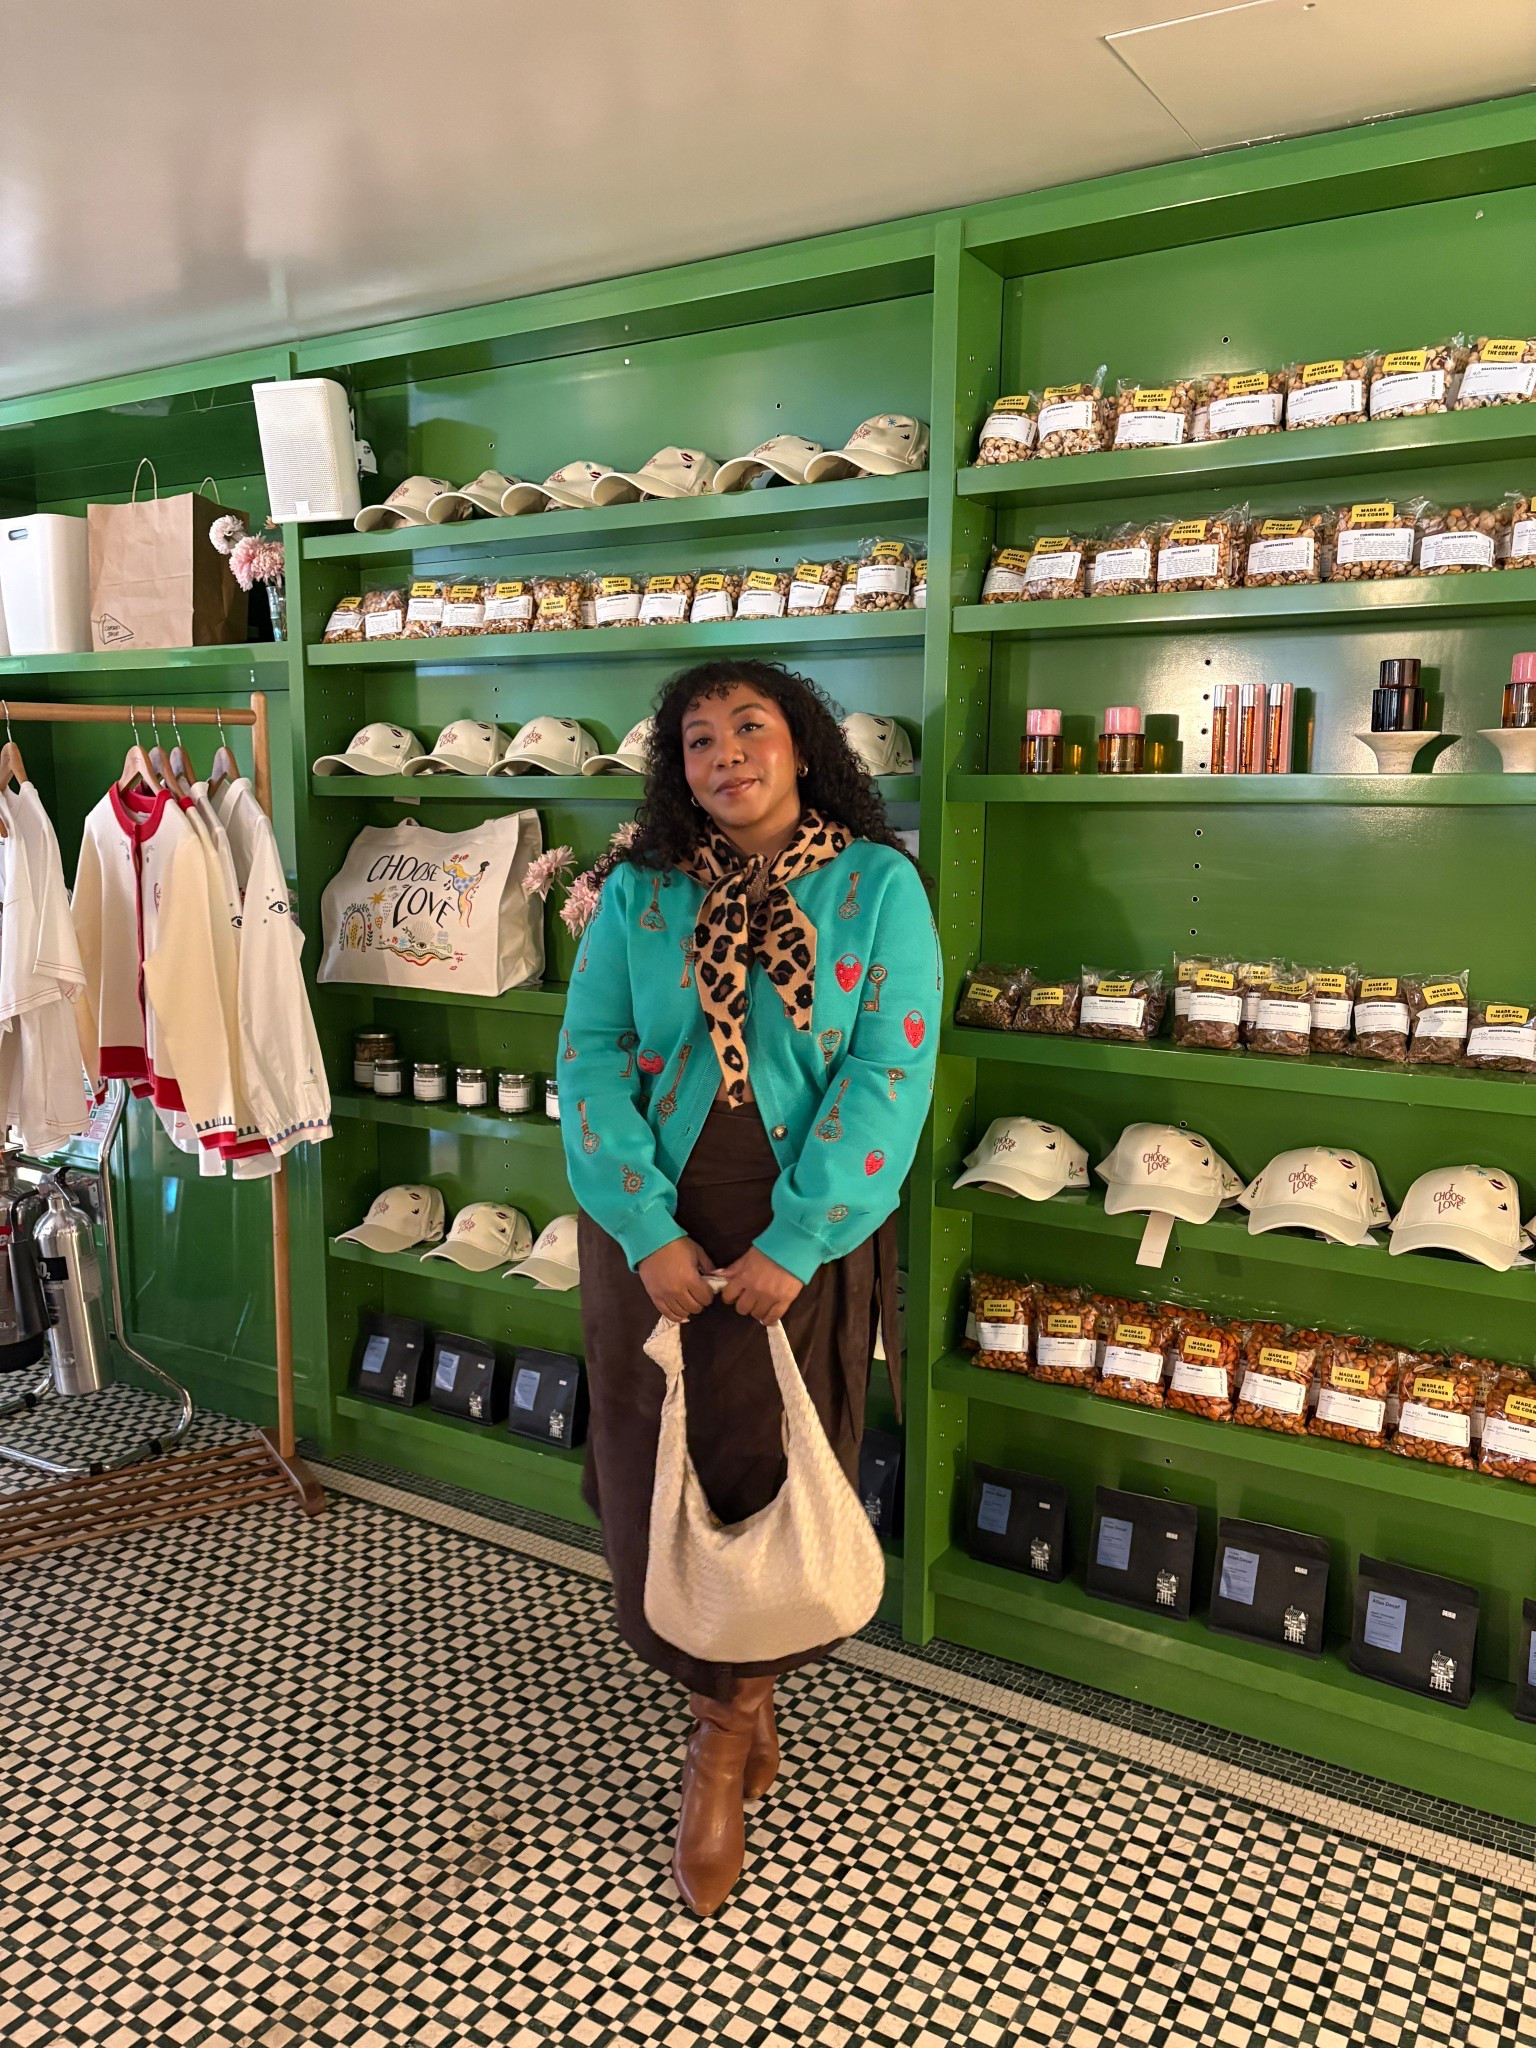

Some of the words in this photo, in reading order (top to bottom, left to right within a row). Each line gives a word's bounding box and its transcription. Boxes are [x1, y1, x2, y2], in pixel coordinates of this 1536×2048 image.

[367, 854, 442, 883] CHOOSE
[393, 886, 455, 929] LOVE
[1157, 1145, 1162, 1153] I
[1143, 1152, 1171, 1164] CHOOSE
[1148, 1161, 1168, 1175] LOVE
[1303, 1164, 1308, 1173] I
[1288, 1172, 1318, 1185] CHOOSE
[1292, 1180, 1315, 1194] LOVE
[1449, 1183, 1455, 1192] I
[1433, 1191, 1466, 1204] CHOOSE
[1438, 1200, 1463, 1214] LOVE
